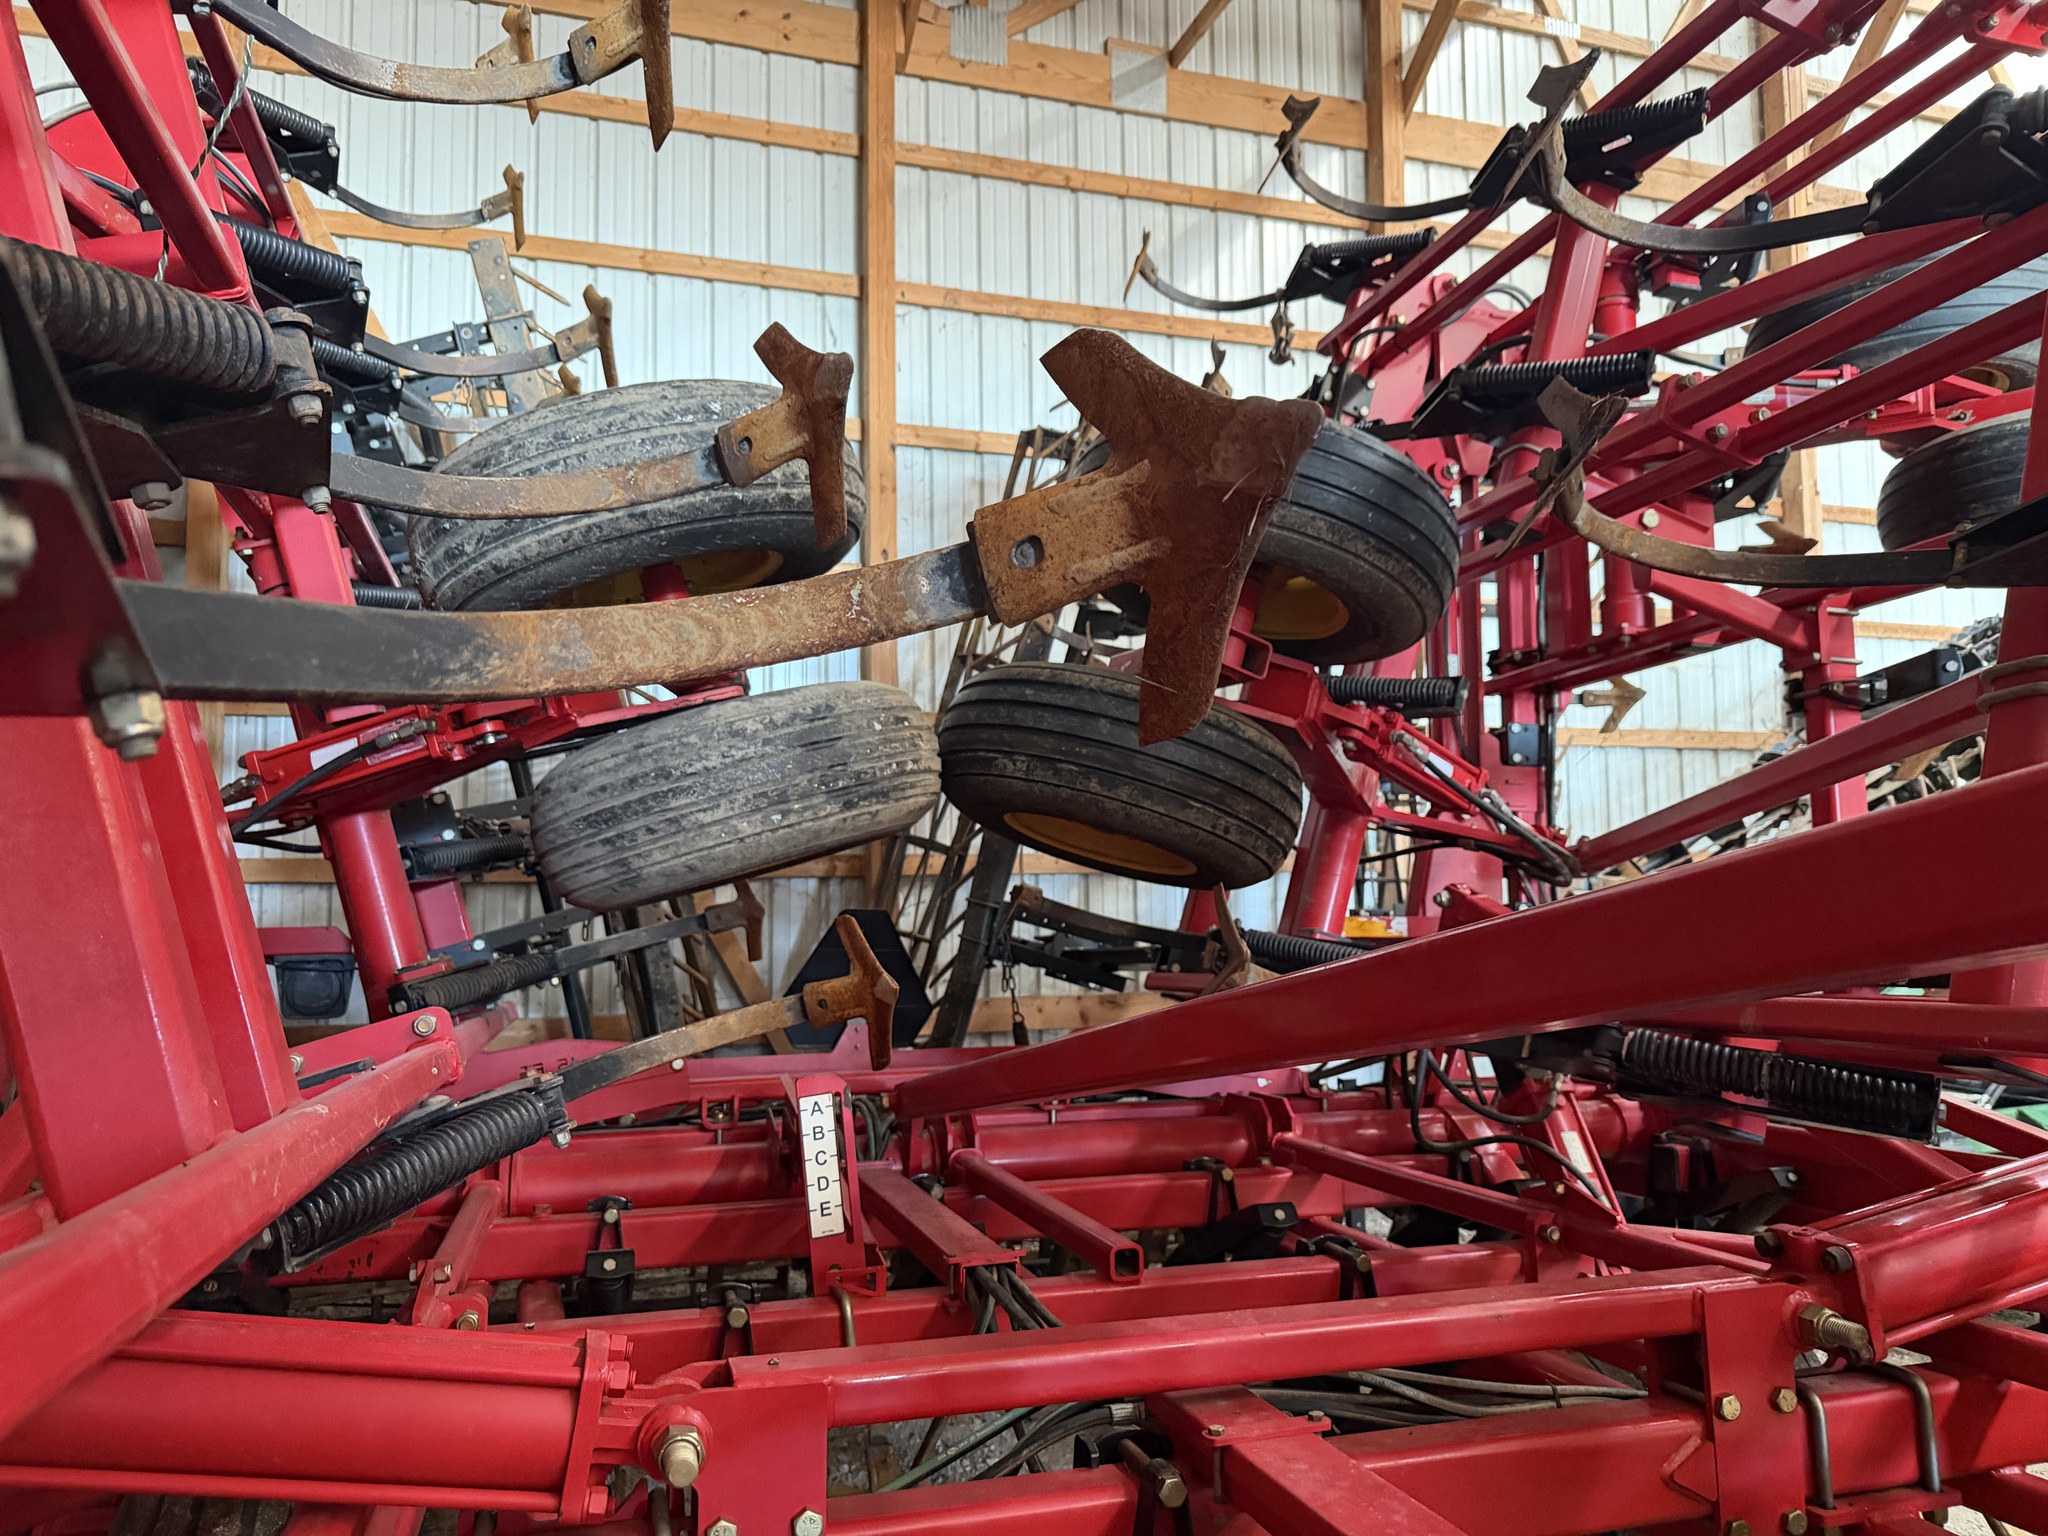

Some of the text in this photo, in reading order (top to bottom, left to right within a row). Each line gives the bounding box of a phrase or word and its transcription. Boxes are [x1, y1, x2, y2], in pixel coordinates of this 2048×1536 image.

[811, 1101, 824, 1116] A
[812, 1126, 825, 1141] B
[815, 1150, 828, 1166] C
[817, 1176, 830, 1191] D
[820, 1201, 832, 1217] E
